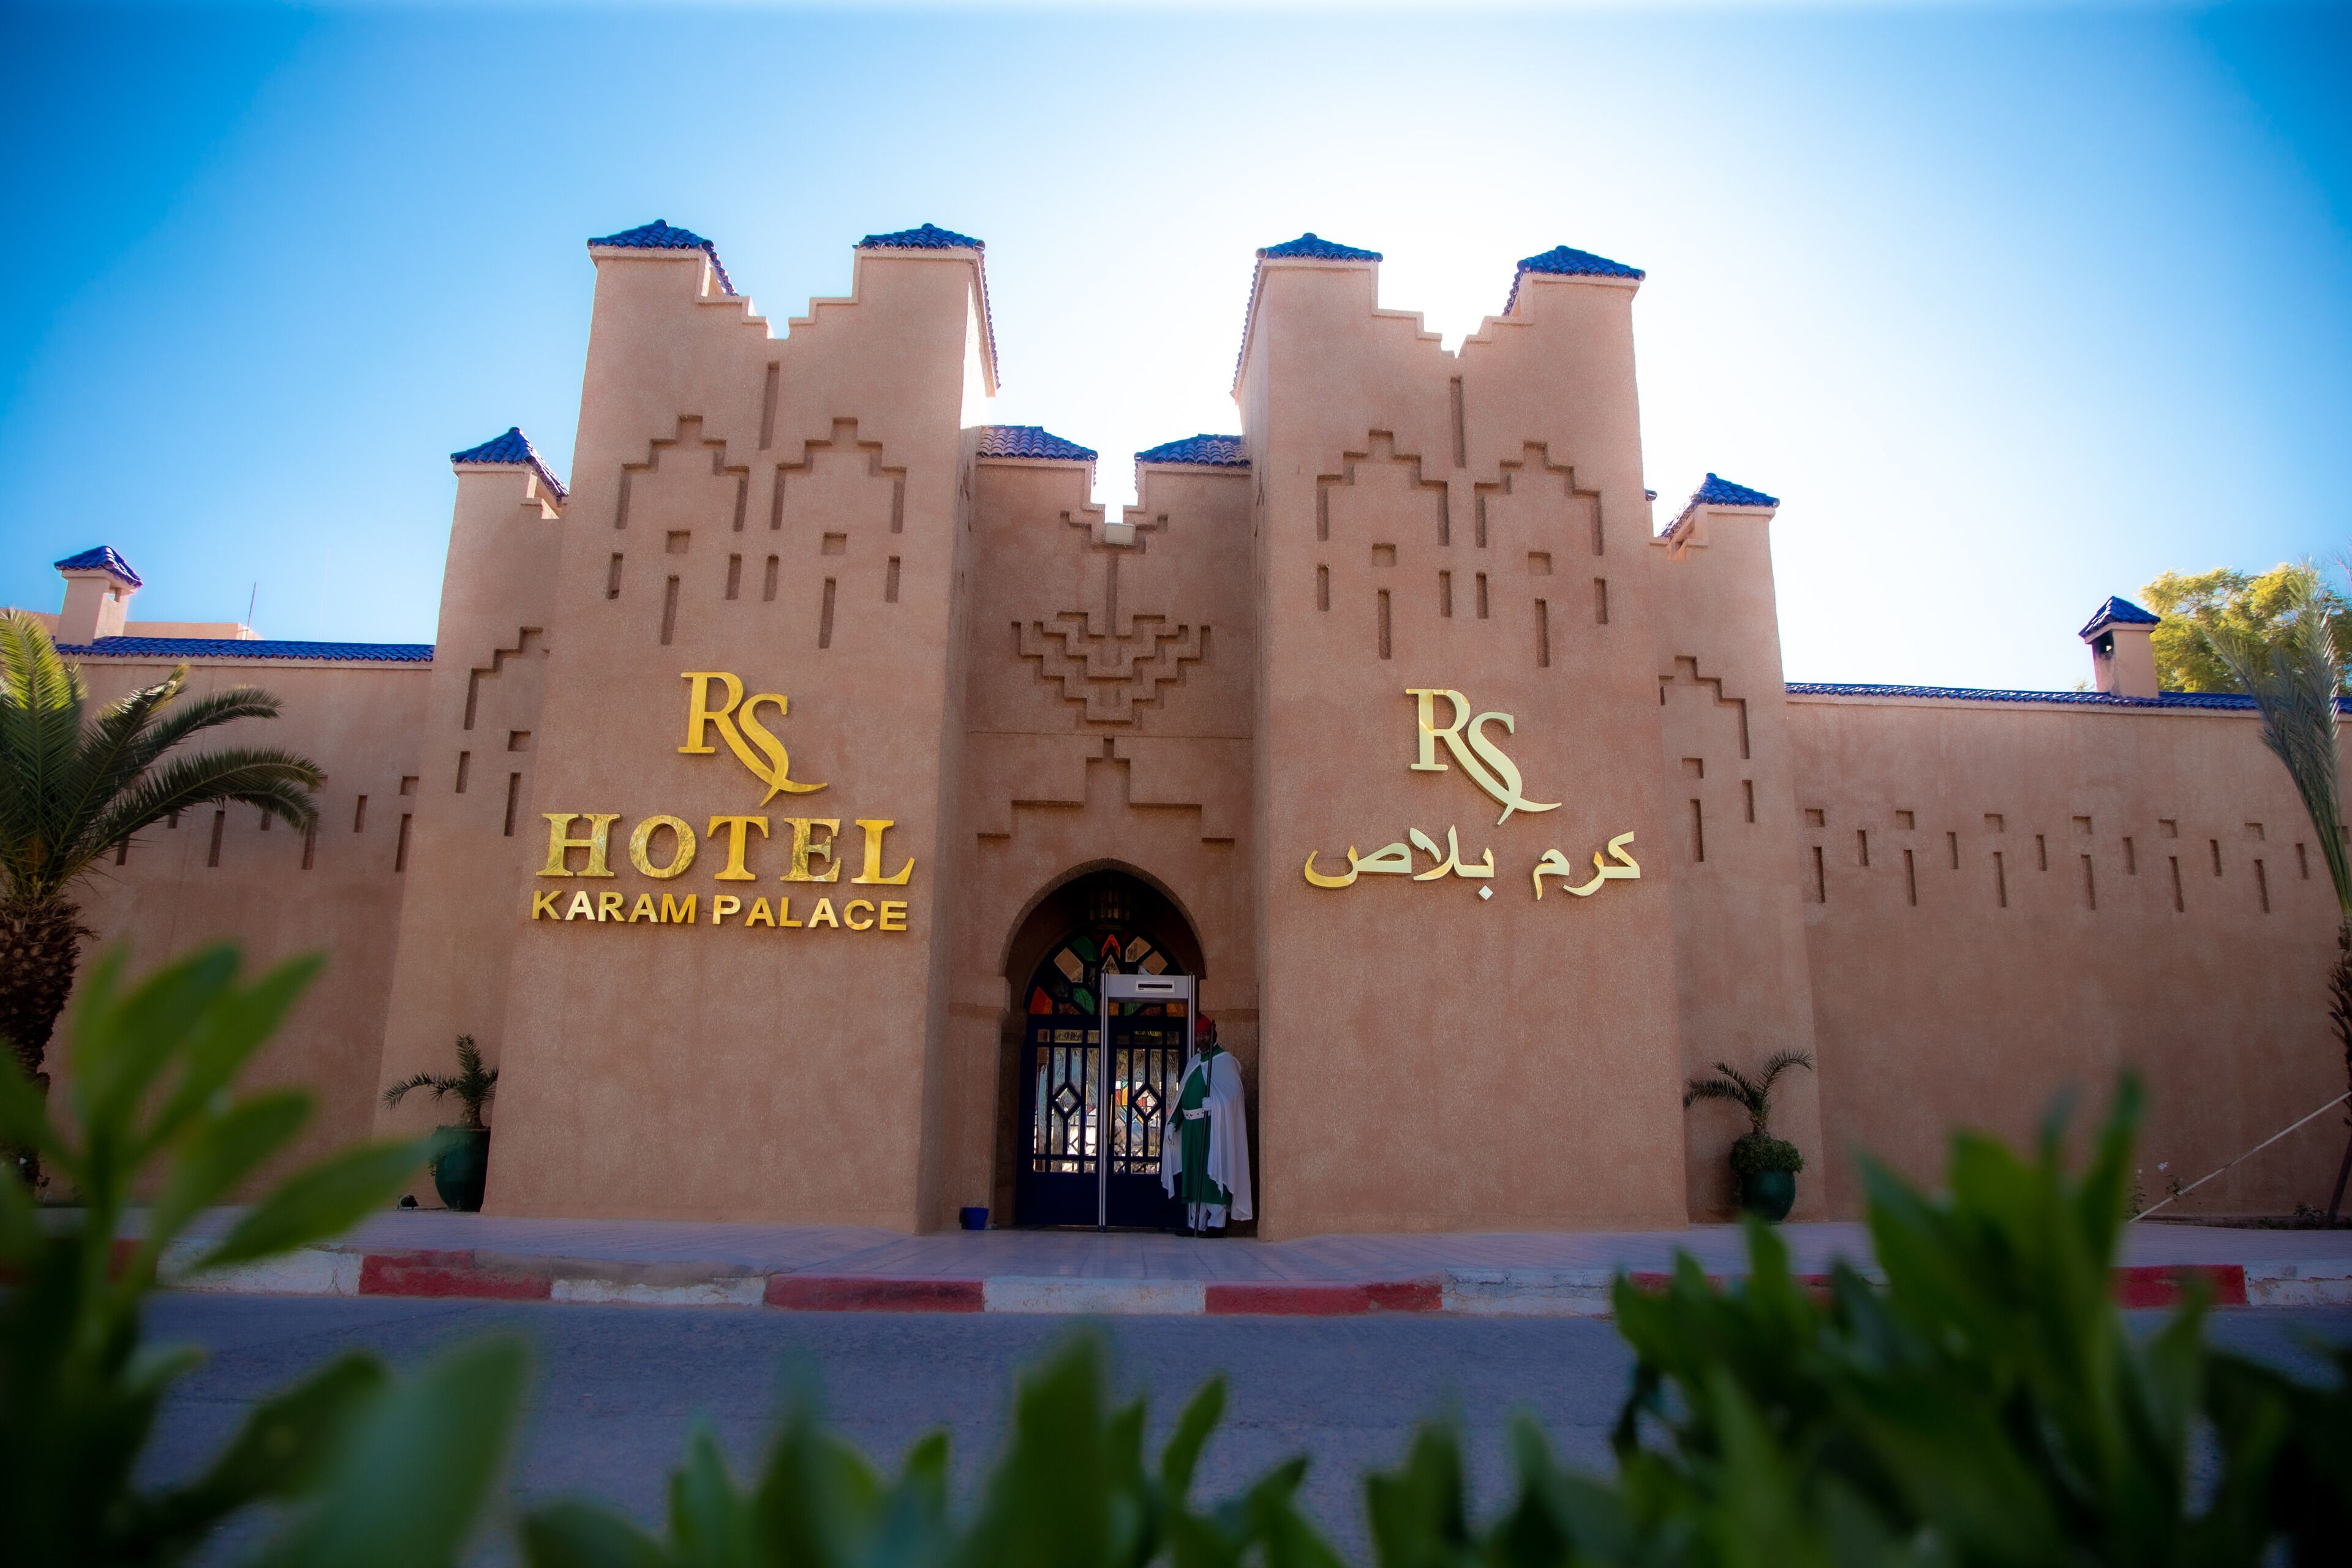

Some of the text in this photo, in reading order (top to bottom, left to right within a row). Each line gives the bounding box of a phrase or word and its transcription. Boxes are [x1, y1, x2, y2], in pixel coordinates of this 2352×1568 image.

[536, 813, 915, 884] HOTEL
[1305, 824, 1640, 900] كرم بلاص
[532, 890, 907, 930] KARAM PALACE
